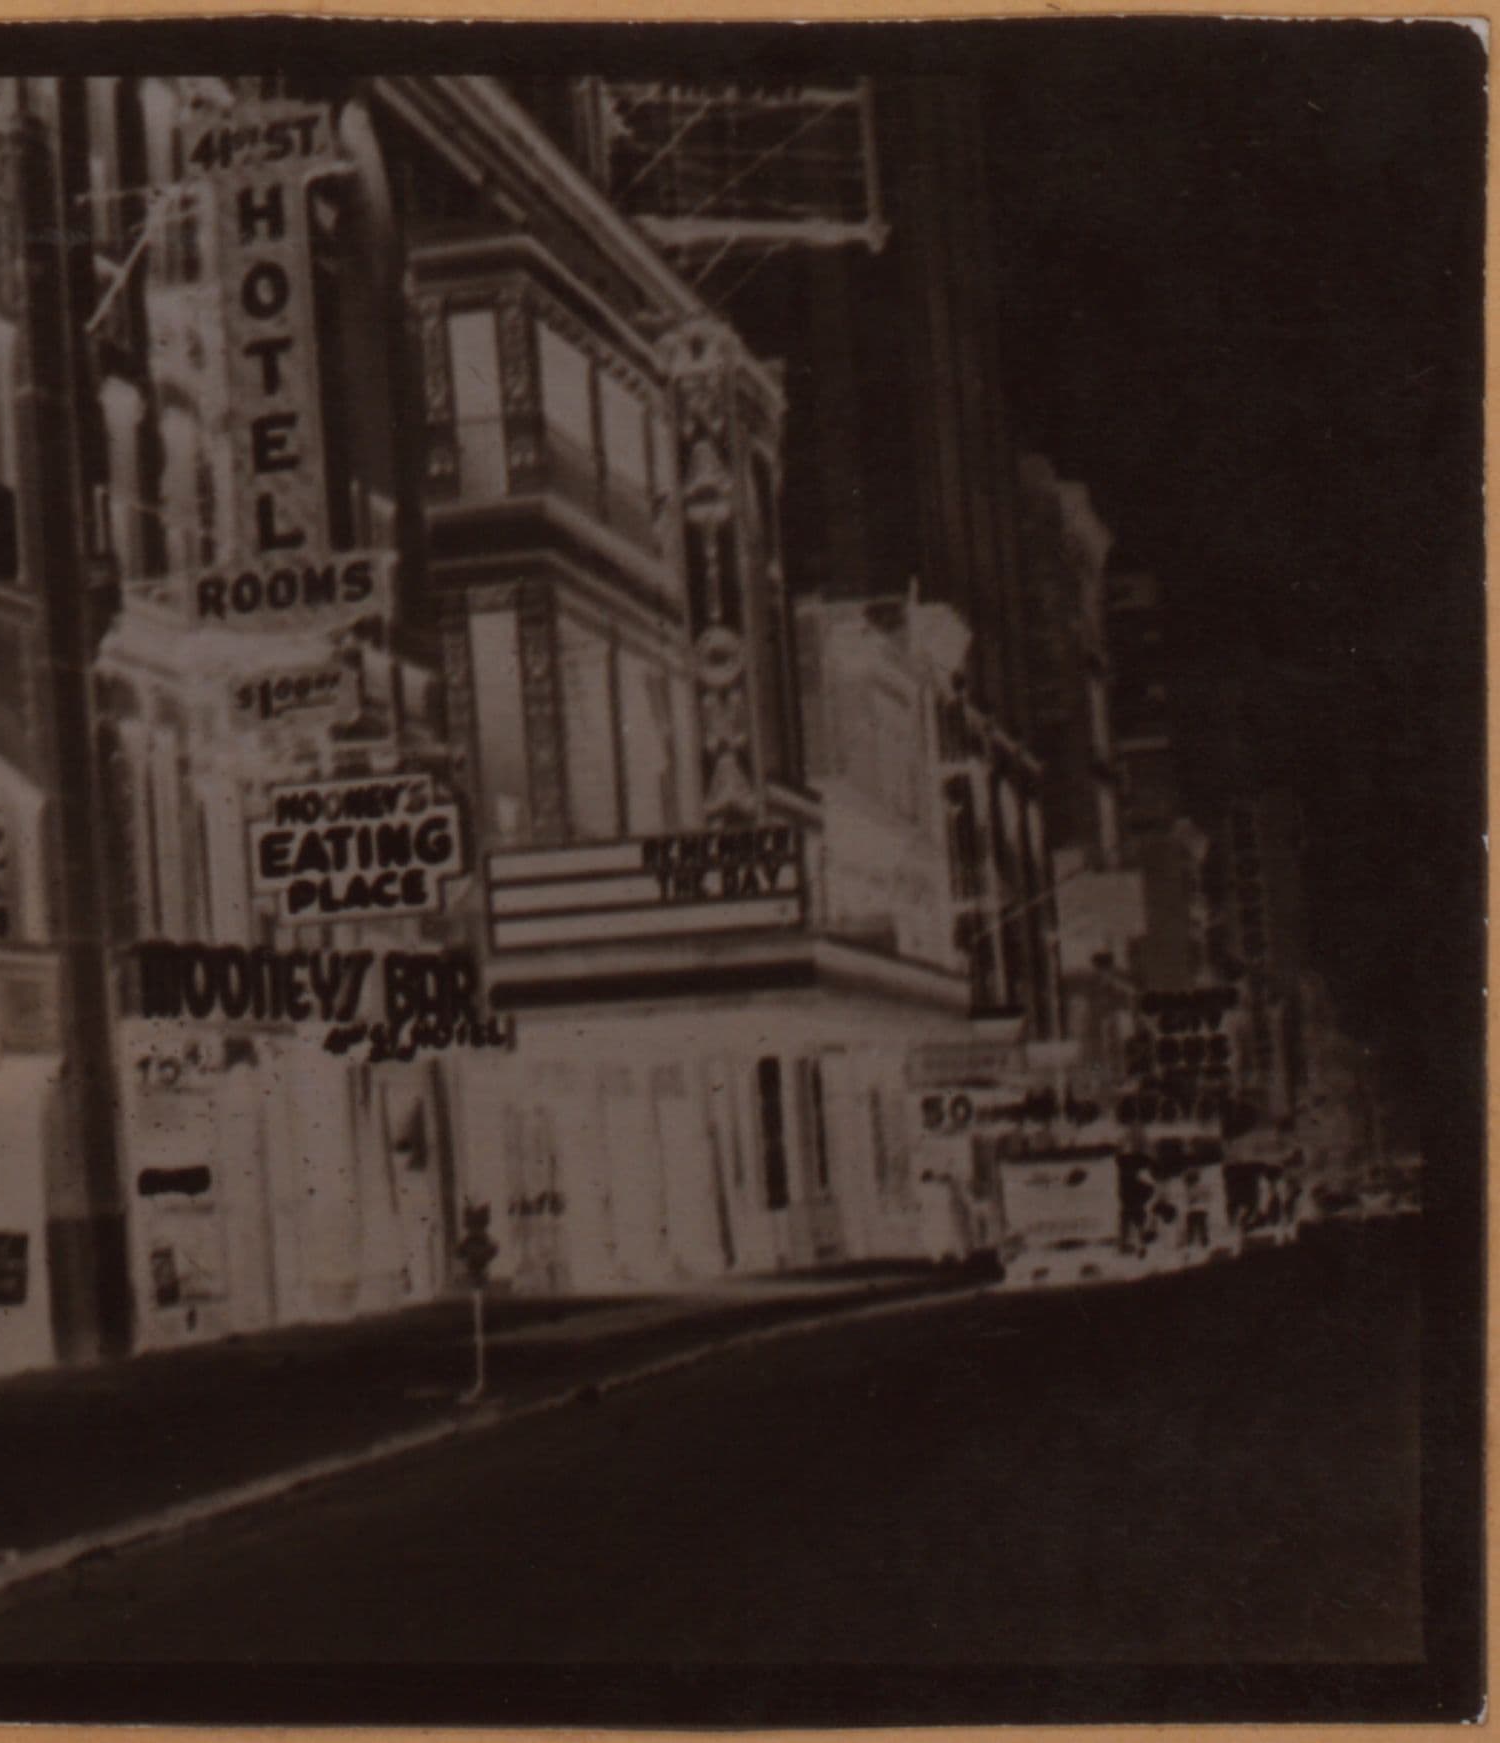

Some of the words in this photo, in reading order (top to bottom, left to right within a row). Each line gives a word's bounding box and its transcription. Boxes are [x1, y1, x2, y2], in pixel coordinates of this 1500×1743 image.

[237, 184, 306, 553] HOTEL
[197, 560, 373, 620] ROOMS
[259, 816, 453, 879] EATING
[287, 868, 428, 914] PLACE
